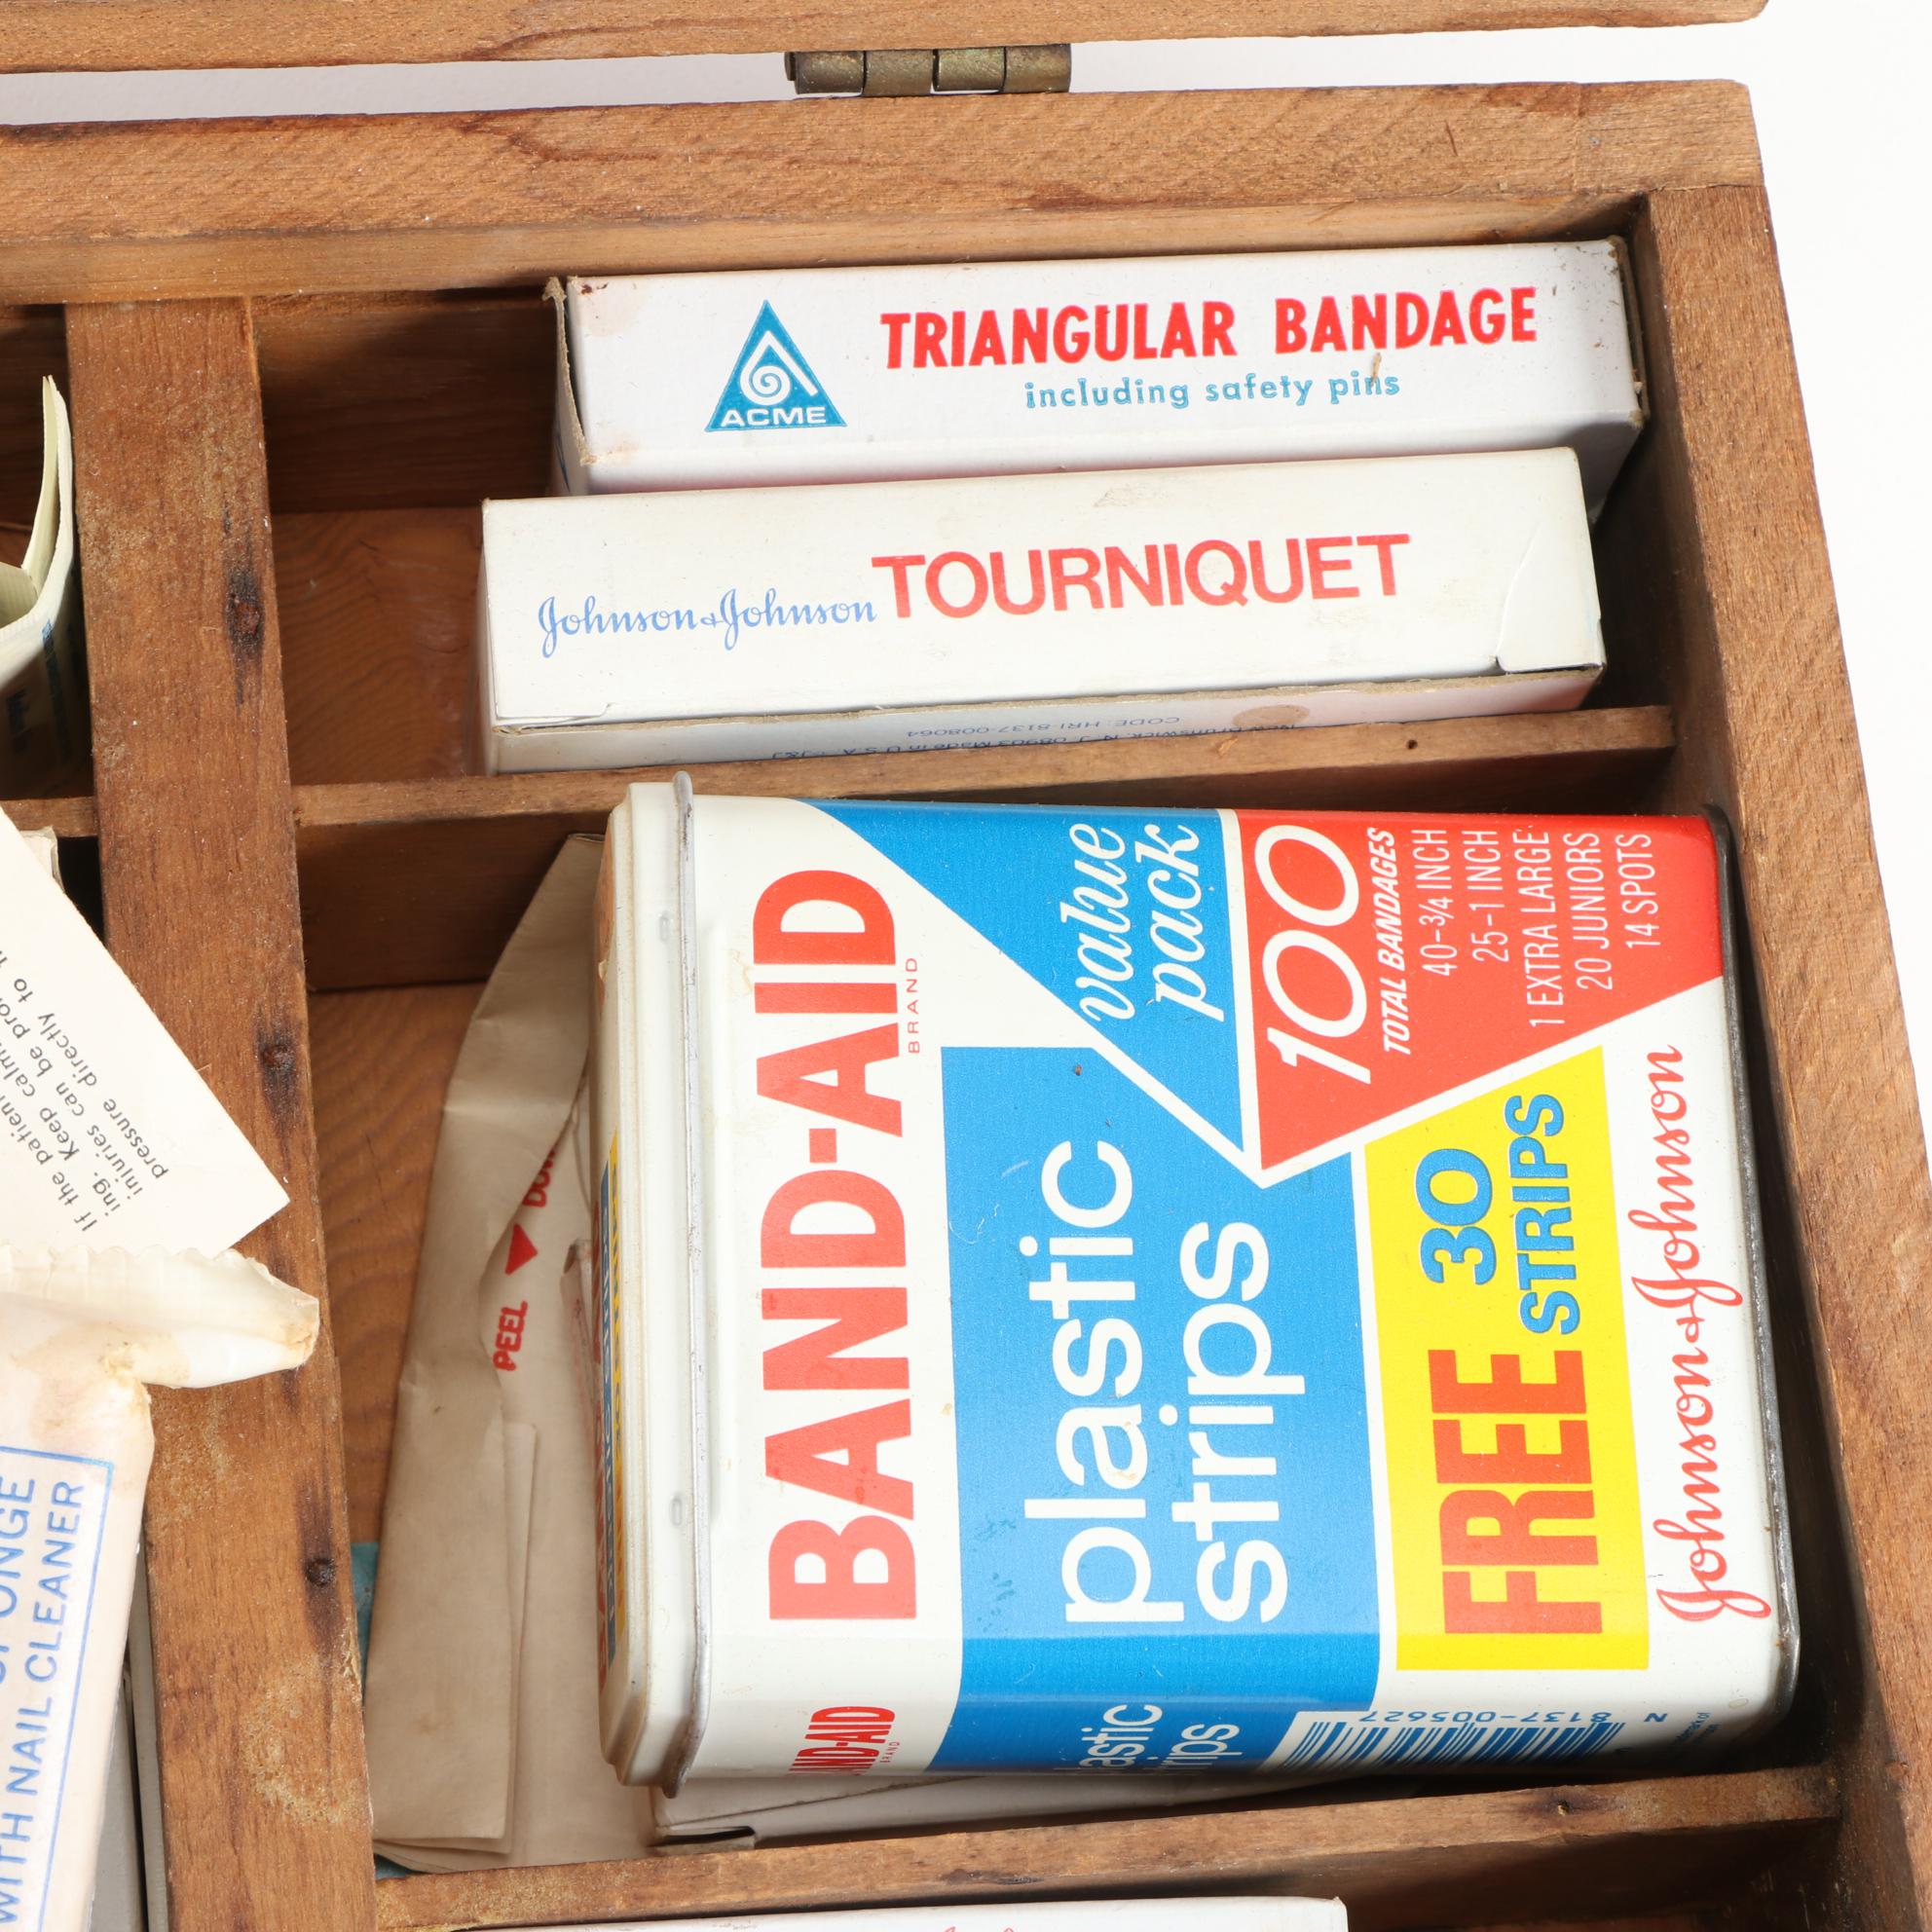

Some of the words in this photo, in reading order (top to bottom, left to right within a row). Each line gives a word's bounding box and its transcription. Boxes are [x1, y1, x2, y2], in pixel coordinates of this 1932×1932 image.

[880, 300, 1238, 369] TRIANGULAR
[1276, 287, 1538, 353] BANDAGE
[721, 406, 827, 427] ACME
[1024, 378, 1190, 410] including
[1206, 372, 1313, 406] safety
[1328, 370, 1400, 404] pins
[872, 534, 1411, 619] TOURNIQUET
[1367, 827, 1405, 971] BANDAGES
[1411, 829, 1451, 892] INCH
[1463, 830, 1503, 893] INCH
[1512, 831, 1556, 913] LARGE
[1563, 832, 1608, 950] JUNIORS
[1616, 833, 1658, 916] SPOTS
[1060, 823, 1135, 1022] value
[1135, 824, 1225, 1022] pack
[1254, 824, 1371, 1084] 100
[1525, 916, 1564, 1008] EXTRA
[1625, 922, 1661, 950] 14
[14, 978, 33, 1003] to
[906, 957, 920, 1054] BRAND
[1577, 954, 1613, 991] 20
[0, 997, 30, 1039] pro
[37, 1013, 97, 1087] directly
[1385, 978, 1411, 1056] TOTAL
[1530, 1016, 1565, 1027] 1
[29, 1045, 54, 1078] be
[56, 1081, 85, 1117] can
[39, 1106, 80, 1161] Keep
[87, 1124, 143, 1200] injuries
[102, 1098, 168, 1179] pressure
[52, 1171, 80, 1206] the
[73, 1211, 98, 1232] If
[93, 1171, 121, 1216] ing.
[1416, 1148, 1497, 1285] 30
[1505, 1094, 1581, 1334] STRIPS
[753, 870, 916, 1620] BAND-AID
[493, 1300, 528, 1371] PEEL
[1020, 1139, 1184, 1622] plastic
[1159, 1221, 1305, 1622] strips
[1429, 1350, 1602, 1633] FREE
[24, 1481, 85, 1682] CLEANER
[6, 1697, 53, 1796] NAIL
[1359, 1710, 1613, 1723] 8137-005627
[0, 1812, 34, 1923] WITH
